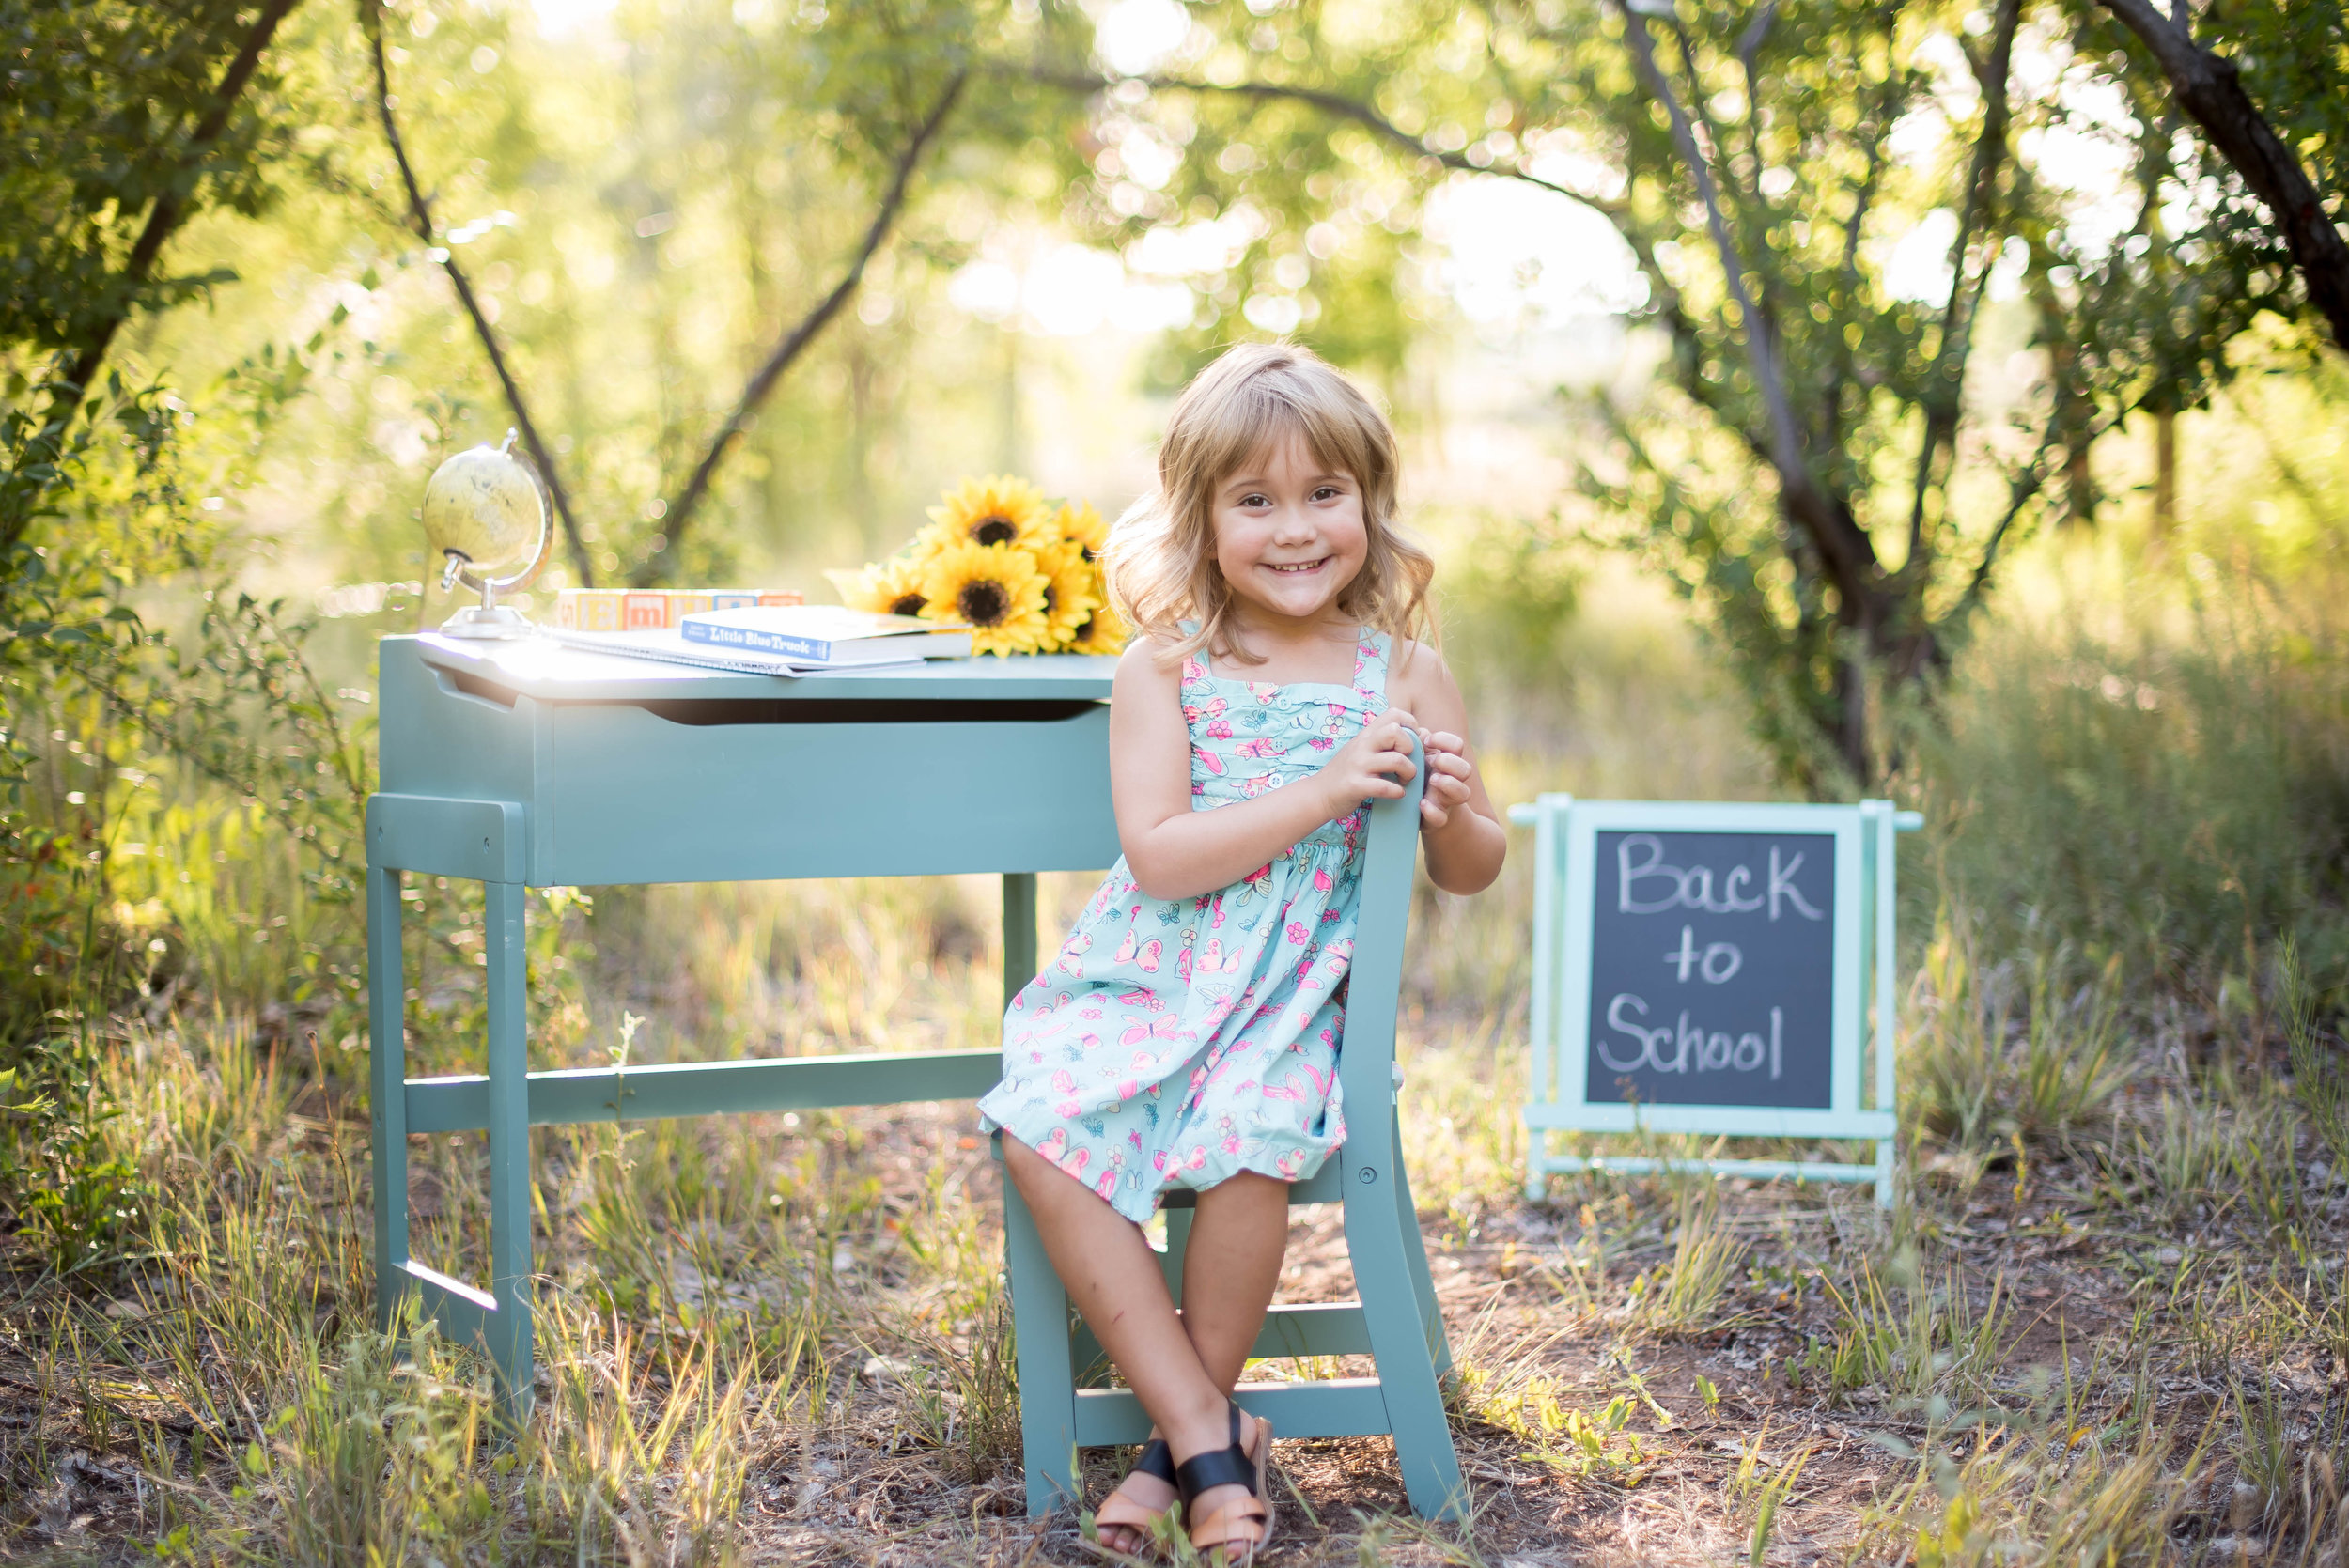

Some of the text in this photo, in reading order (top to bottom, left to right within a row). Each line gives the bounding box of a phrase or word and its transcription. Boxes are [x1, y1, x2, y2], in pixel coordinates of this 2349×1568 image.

[709, 627, 743, 643] Little
[745, 631, 771, 646] Blue
[771, 634, 810, 654] Truck
[1663, 924, 1743, 985] to
[1597, 992, 1782, 1080] School
